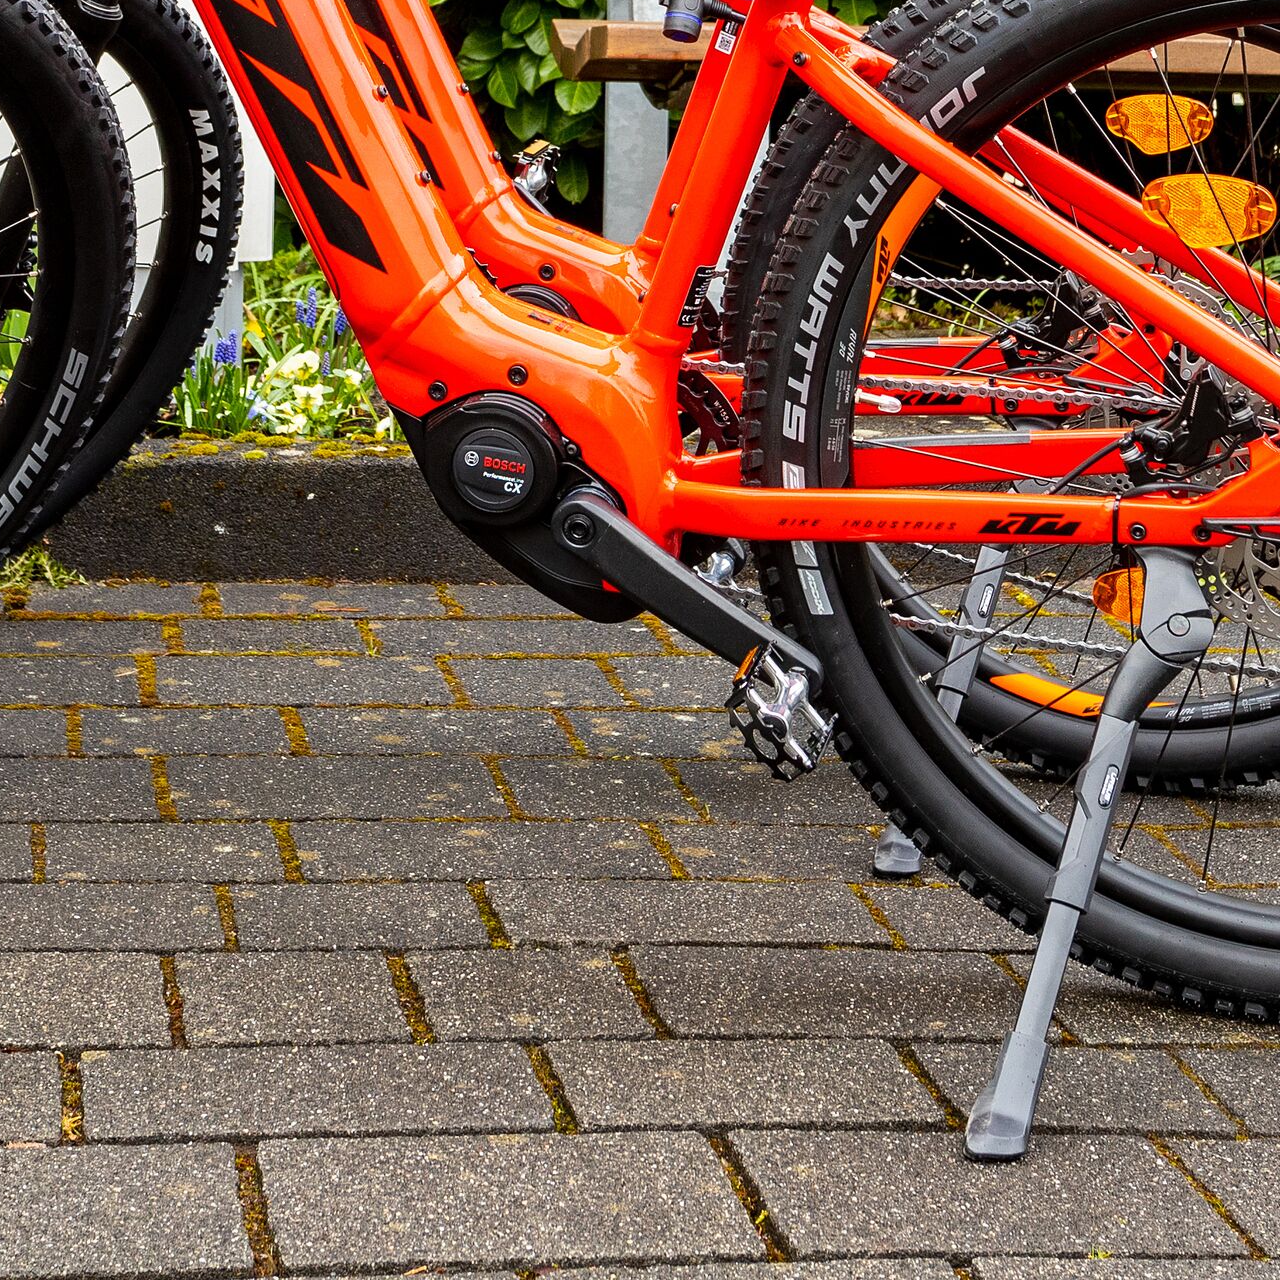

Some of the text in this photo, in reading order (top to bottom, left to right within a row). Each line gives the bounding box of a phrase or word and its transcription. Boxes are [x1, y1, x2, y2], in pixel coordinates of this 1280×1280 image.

[188, 109, 221, 264] MAXXIS
[782, 66, 985, 443] JONNY WATTS
[838, 340, 847, 358] 30
[846, 327, 857, 364] RIVAL
[483, 456, 526, 474] BOSCH
[503, 481, 523, 494] CX
[778, 518, 957, 531] BIKE INDUSTRIES
[978, 513, 1082, 536] KTM
